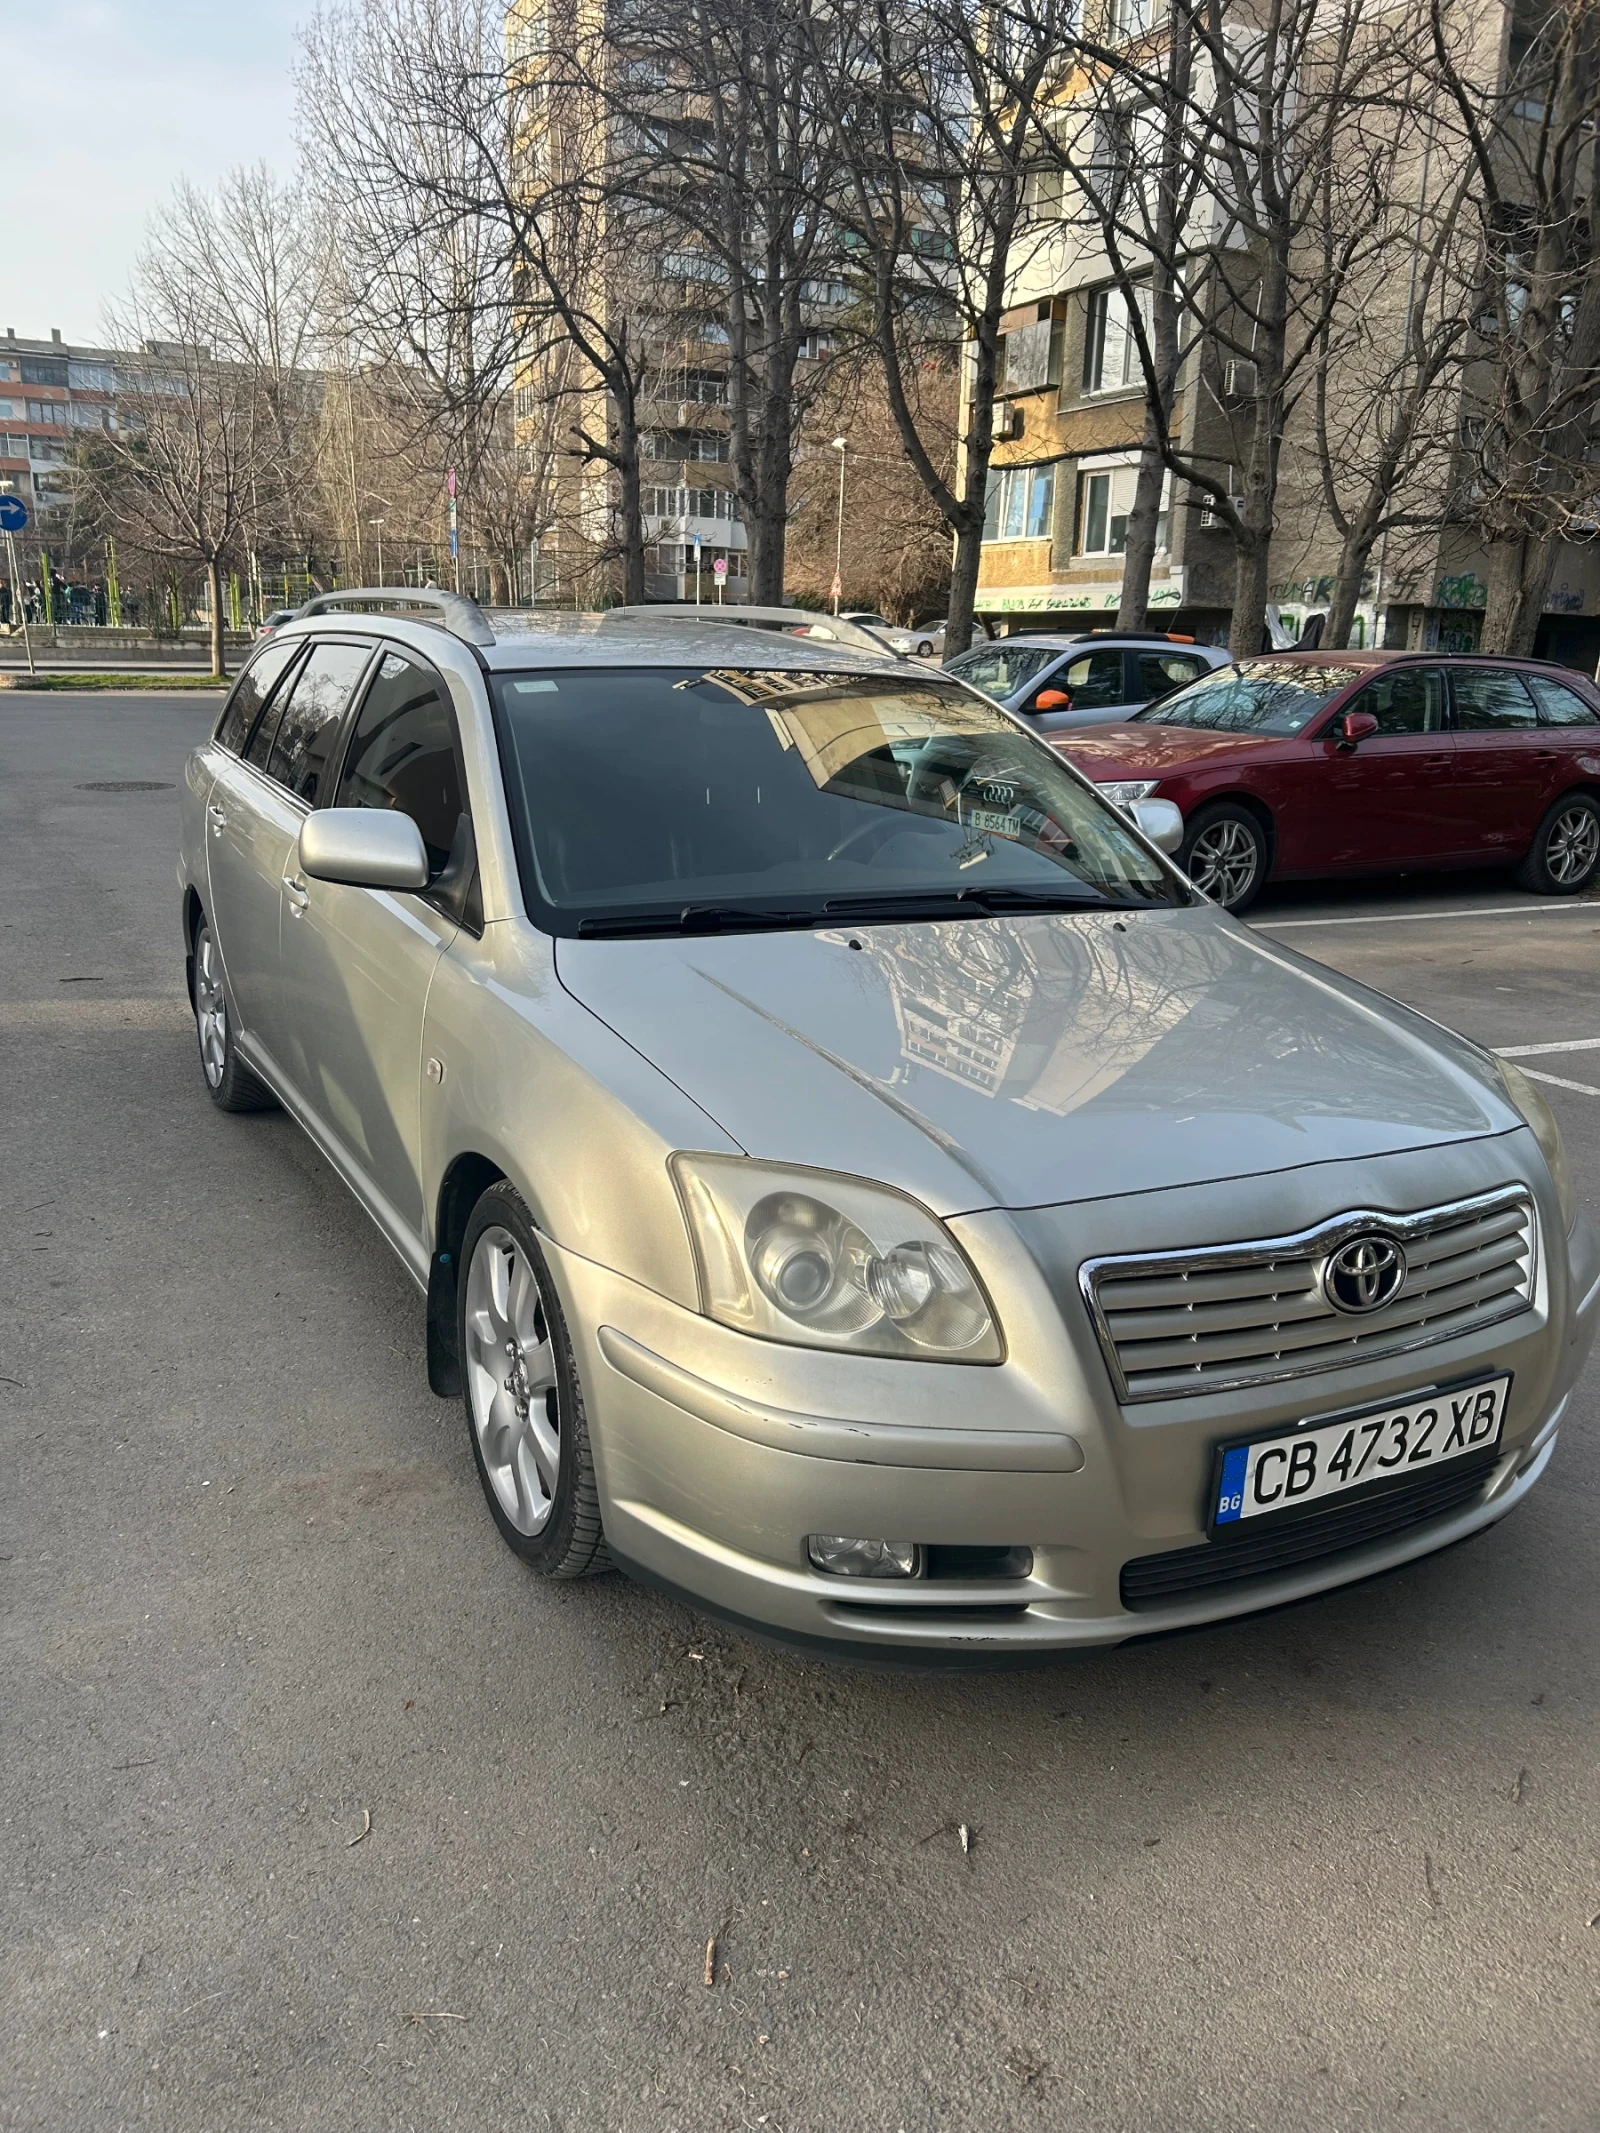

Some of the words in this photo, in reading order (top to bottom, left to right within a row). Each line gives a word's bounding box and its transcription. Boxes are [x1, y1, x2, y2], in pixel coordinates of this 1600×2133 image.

[975, 812, 980, 826] B
[984, 814, 1006, 831] 8564
[1008, 818, 1019, 835] TM
[1253, 1441, 1317, 1504] CB
[1327, 1408, 1438, 1482] 4732
[1442, 1389, 1496, 1453] XB
[1218, 1493, 1240, 1513] BG
